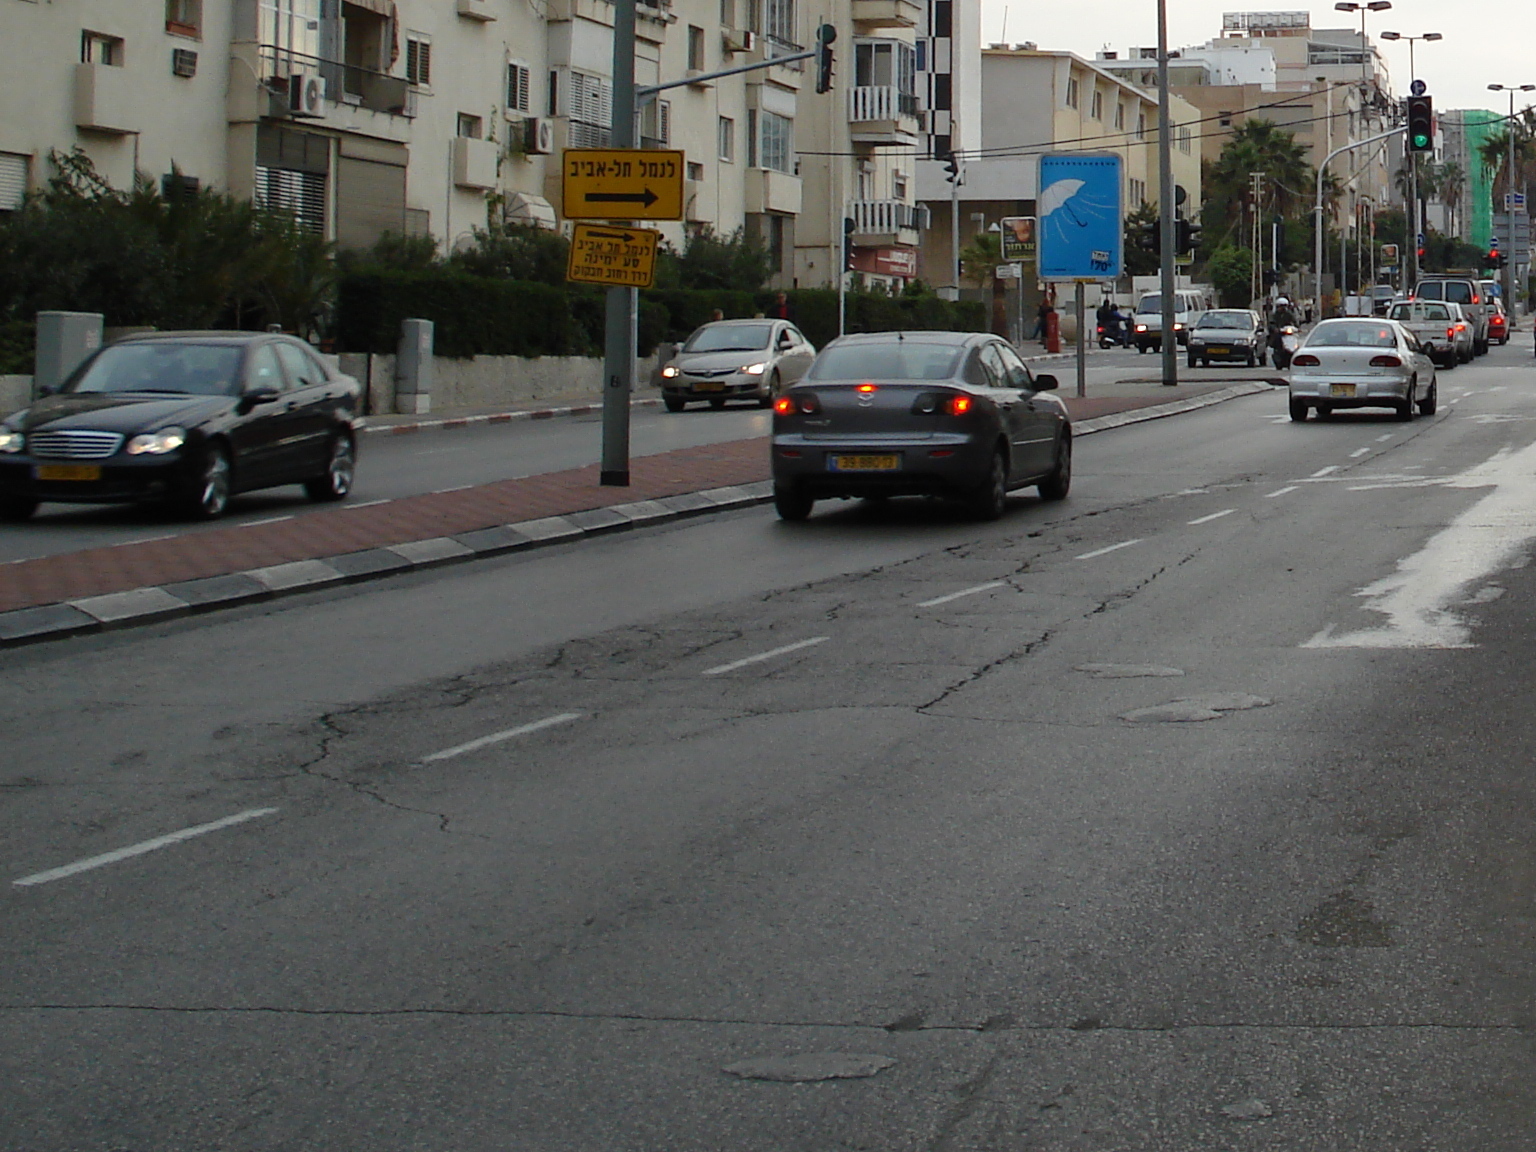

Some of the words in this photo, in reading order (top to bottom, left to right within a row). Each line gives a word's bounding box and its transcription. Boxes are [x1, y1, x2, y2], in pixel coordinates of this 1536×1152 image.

[570, 159, 632, 178] תל-אביב
[639, 160, 675, 178] לנמל
[577, 239, 603, 251] אביב
[607, 242, 621, 254] תל
[624, 244, 650, 256] לנמל
[584, 253, 617, 265] ימינה
[623, 257, 639, 268] סע
[631, 270, 648, 281] דרך
